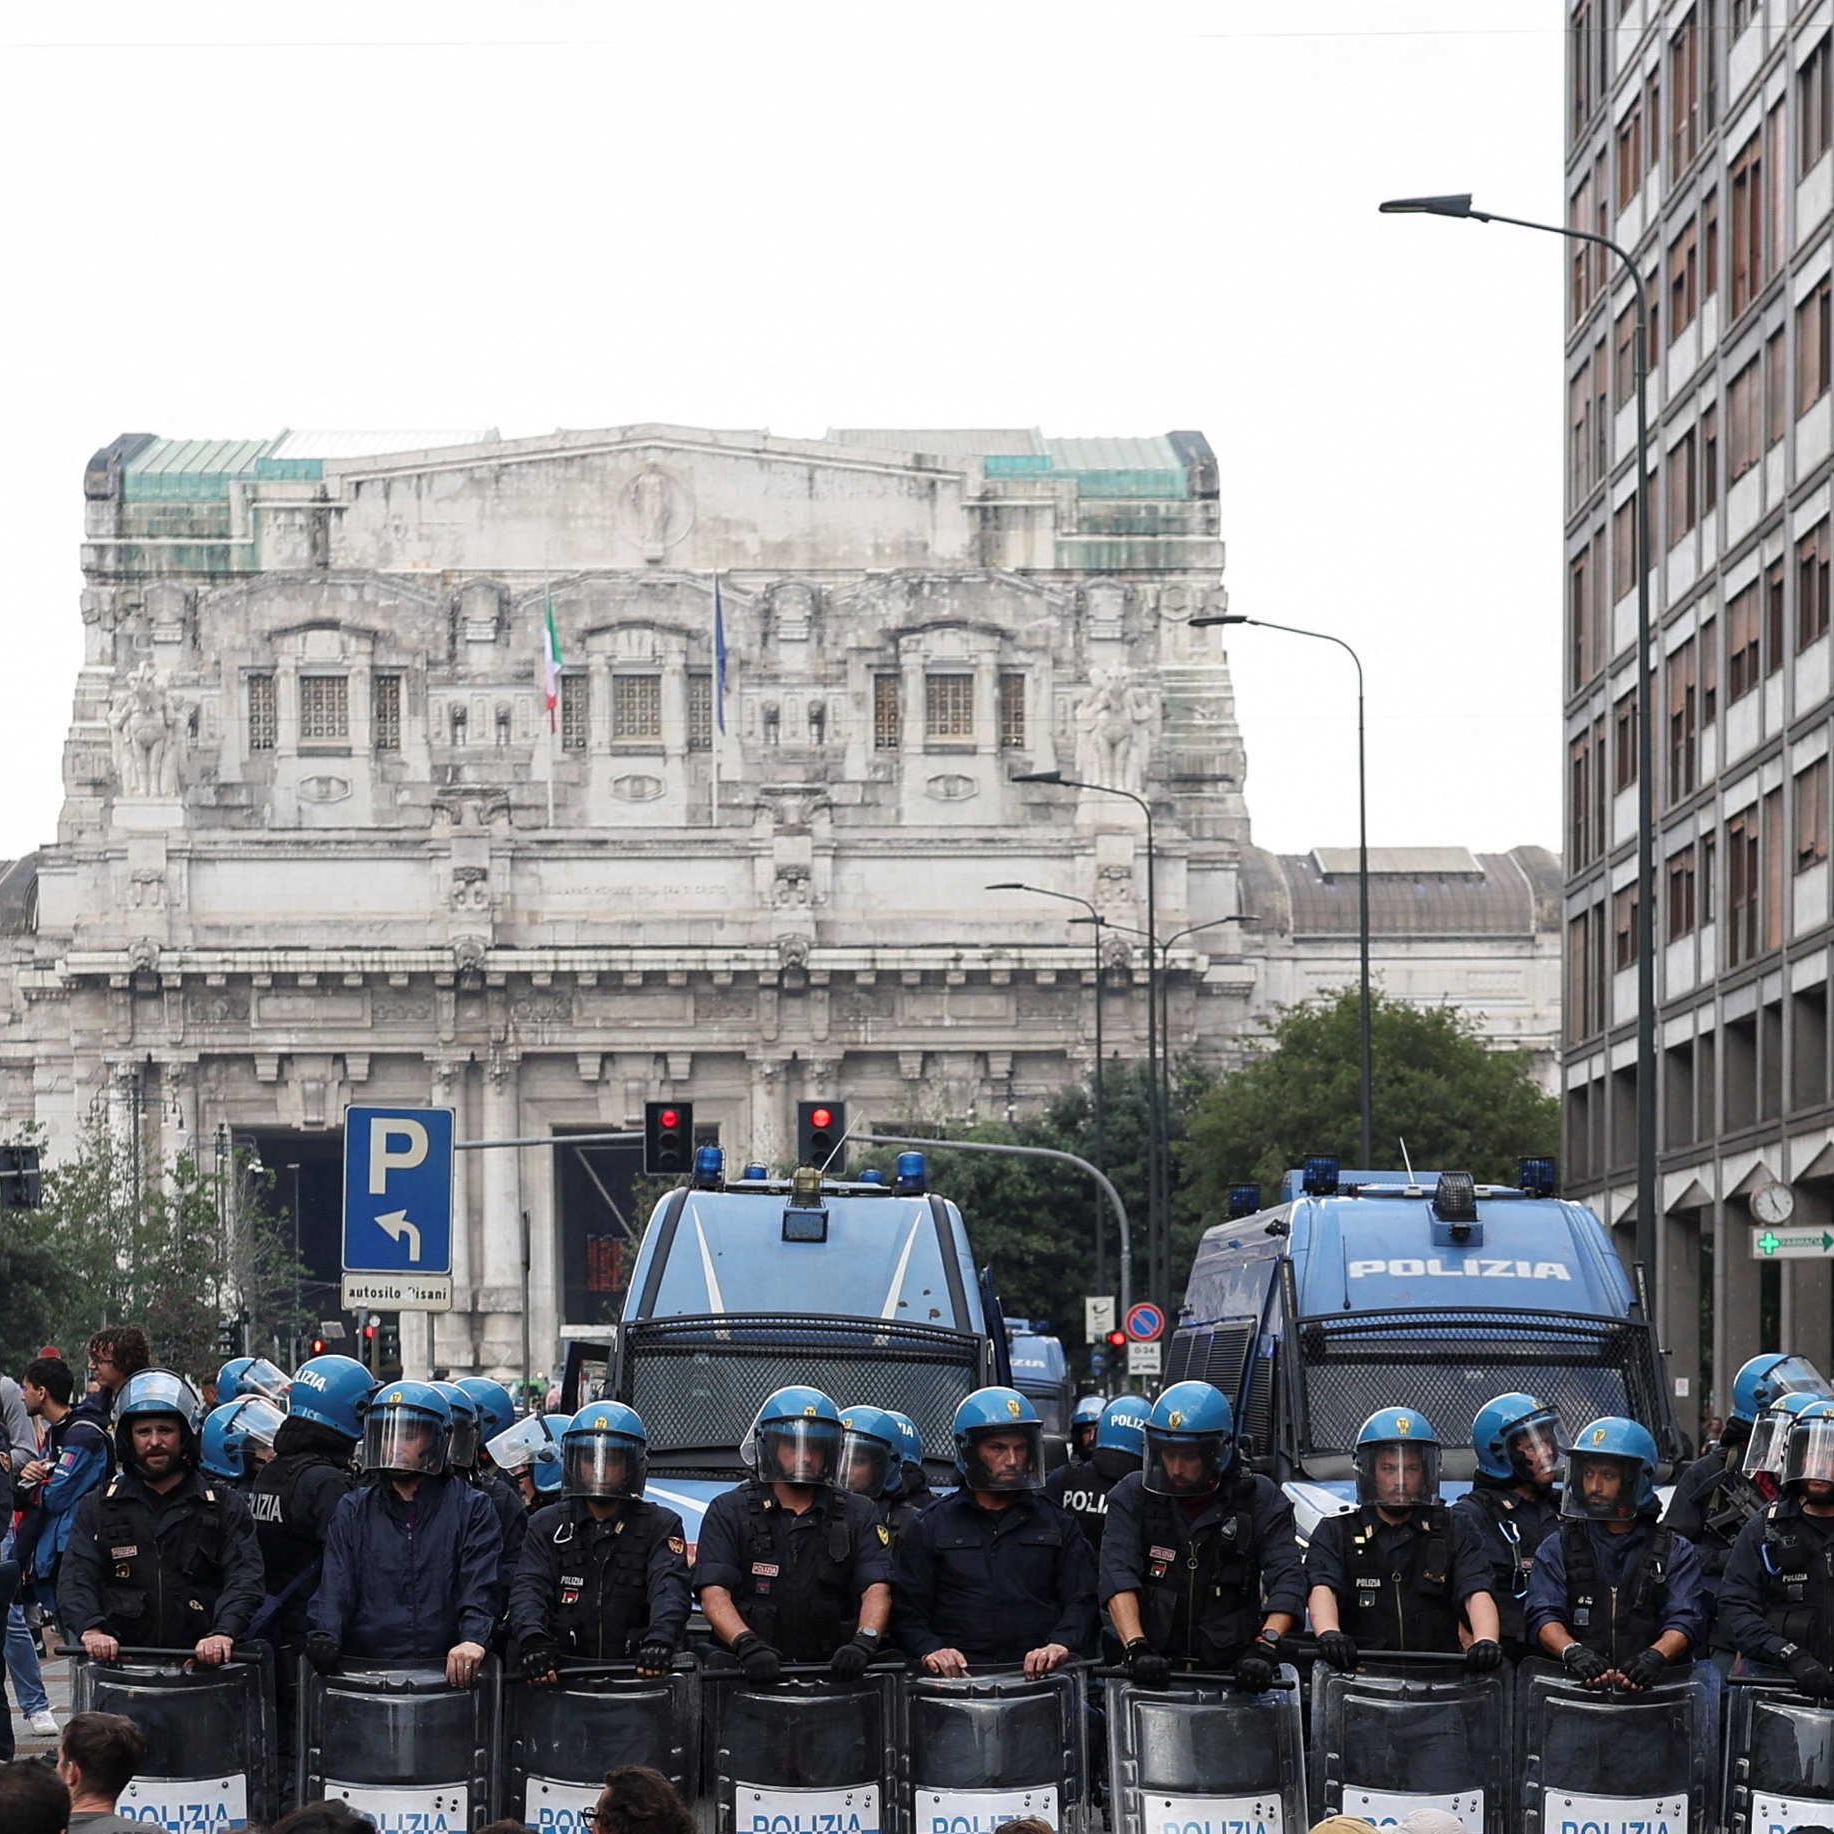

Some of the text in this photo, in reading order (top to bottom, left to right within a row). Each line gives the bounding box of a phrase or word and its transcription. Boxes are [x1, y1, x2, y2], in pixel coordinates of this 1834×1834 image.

[368, 1117, 429, 1195] P
[1349, 1258, 1572, 1281] POLIZIA
[349, 1286, 401, 1300] autosilo
[560, 1575, 584, 1586] POLIZIA
[1356, 1578, 1381, 1587] POLIZIA
[1782, 1573, 1808, 1582] POLIZIA
